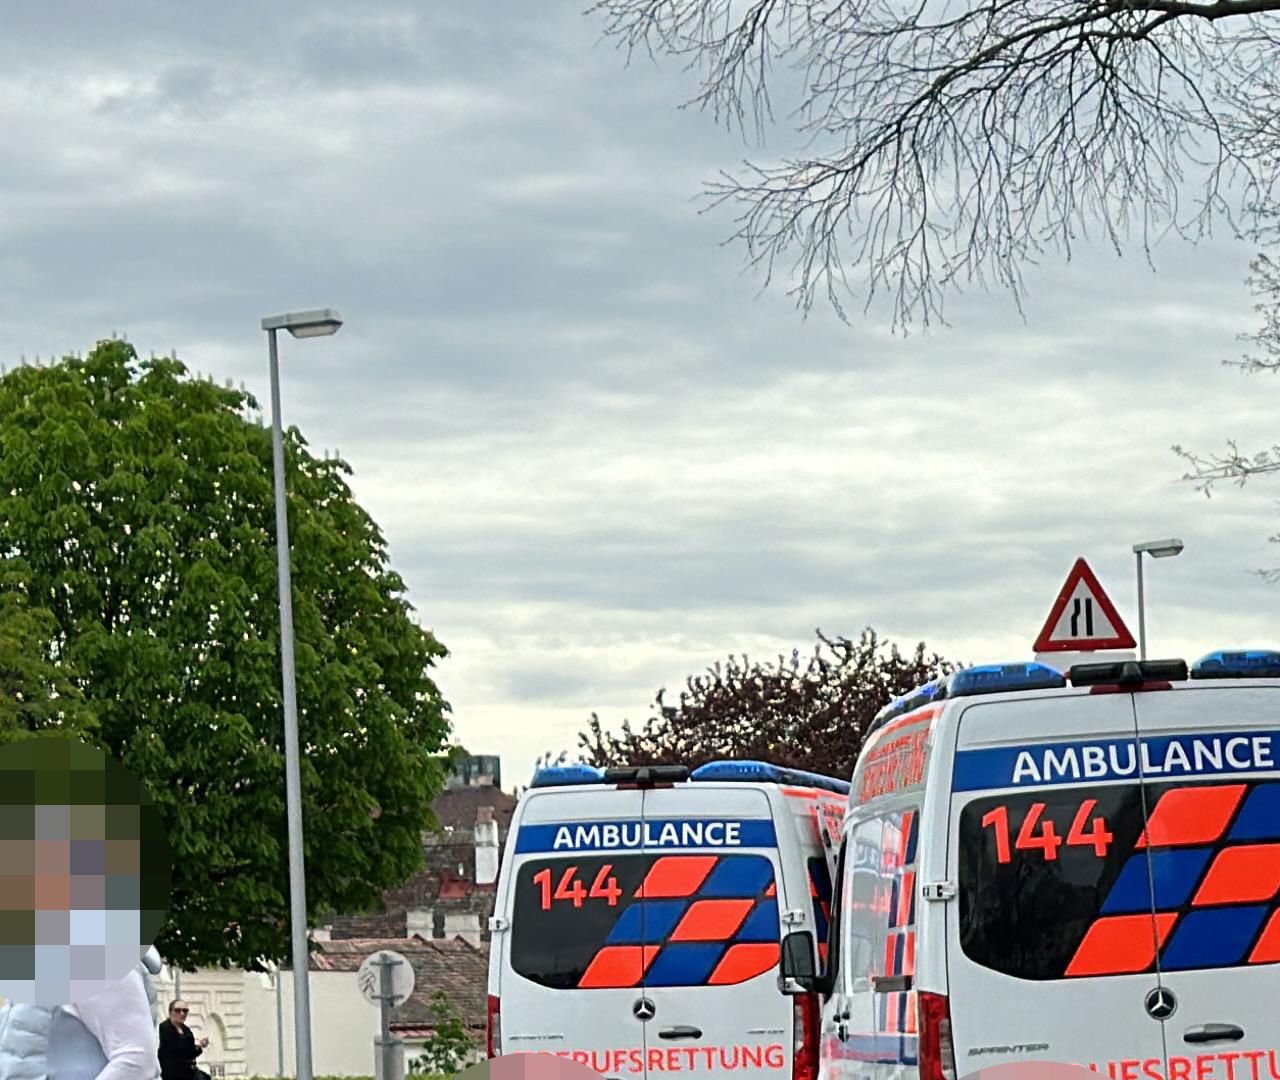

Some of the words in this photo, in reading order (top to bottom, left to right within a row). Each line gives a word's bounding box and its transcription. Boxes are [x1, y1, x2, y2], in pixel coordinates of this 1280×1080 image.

[1012, 736, 1274, 783] AMBULANCE
[553, 822, 741, 849] AMBULANCE
[981, 799, 1113, 865] 144
[533, 864, 623, 910] 144
[538, 1045, 785, 1073] RUFSRETTUNG
[968, 1043, 1049, 1056] SPRINTER
